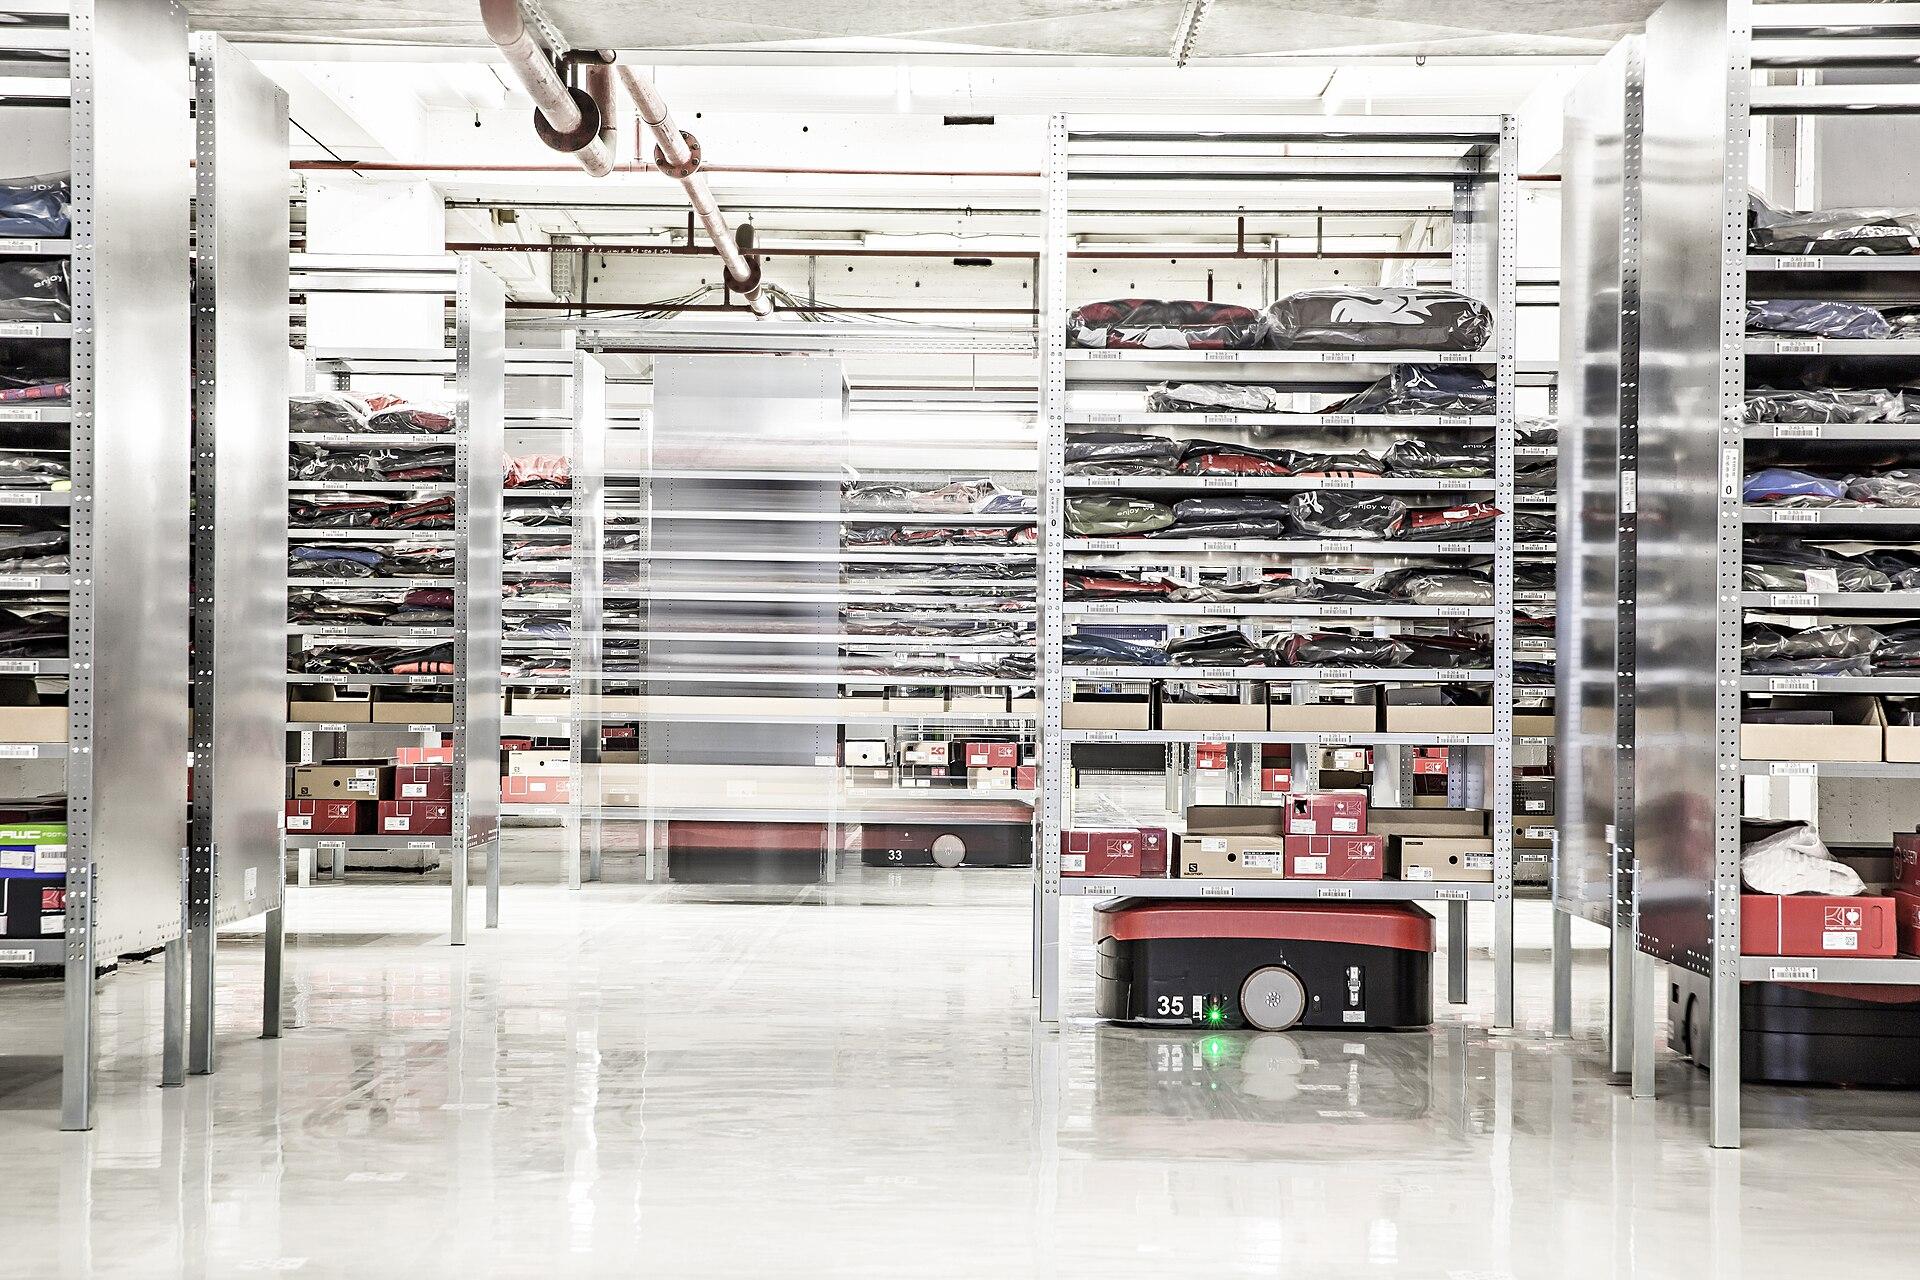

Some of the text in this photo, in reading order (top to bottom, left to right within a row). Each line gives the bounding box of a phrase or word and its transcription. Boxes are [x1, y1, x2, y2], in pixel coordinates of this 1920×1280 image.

[33, 274, 63, 289] enjoy
[1116, 507, 1140, 517] enjoy
[888, 850, 902, 860] 33
[1157, 995, 1184, 1015] 35
